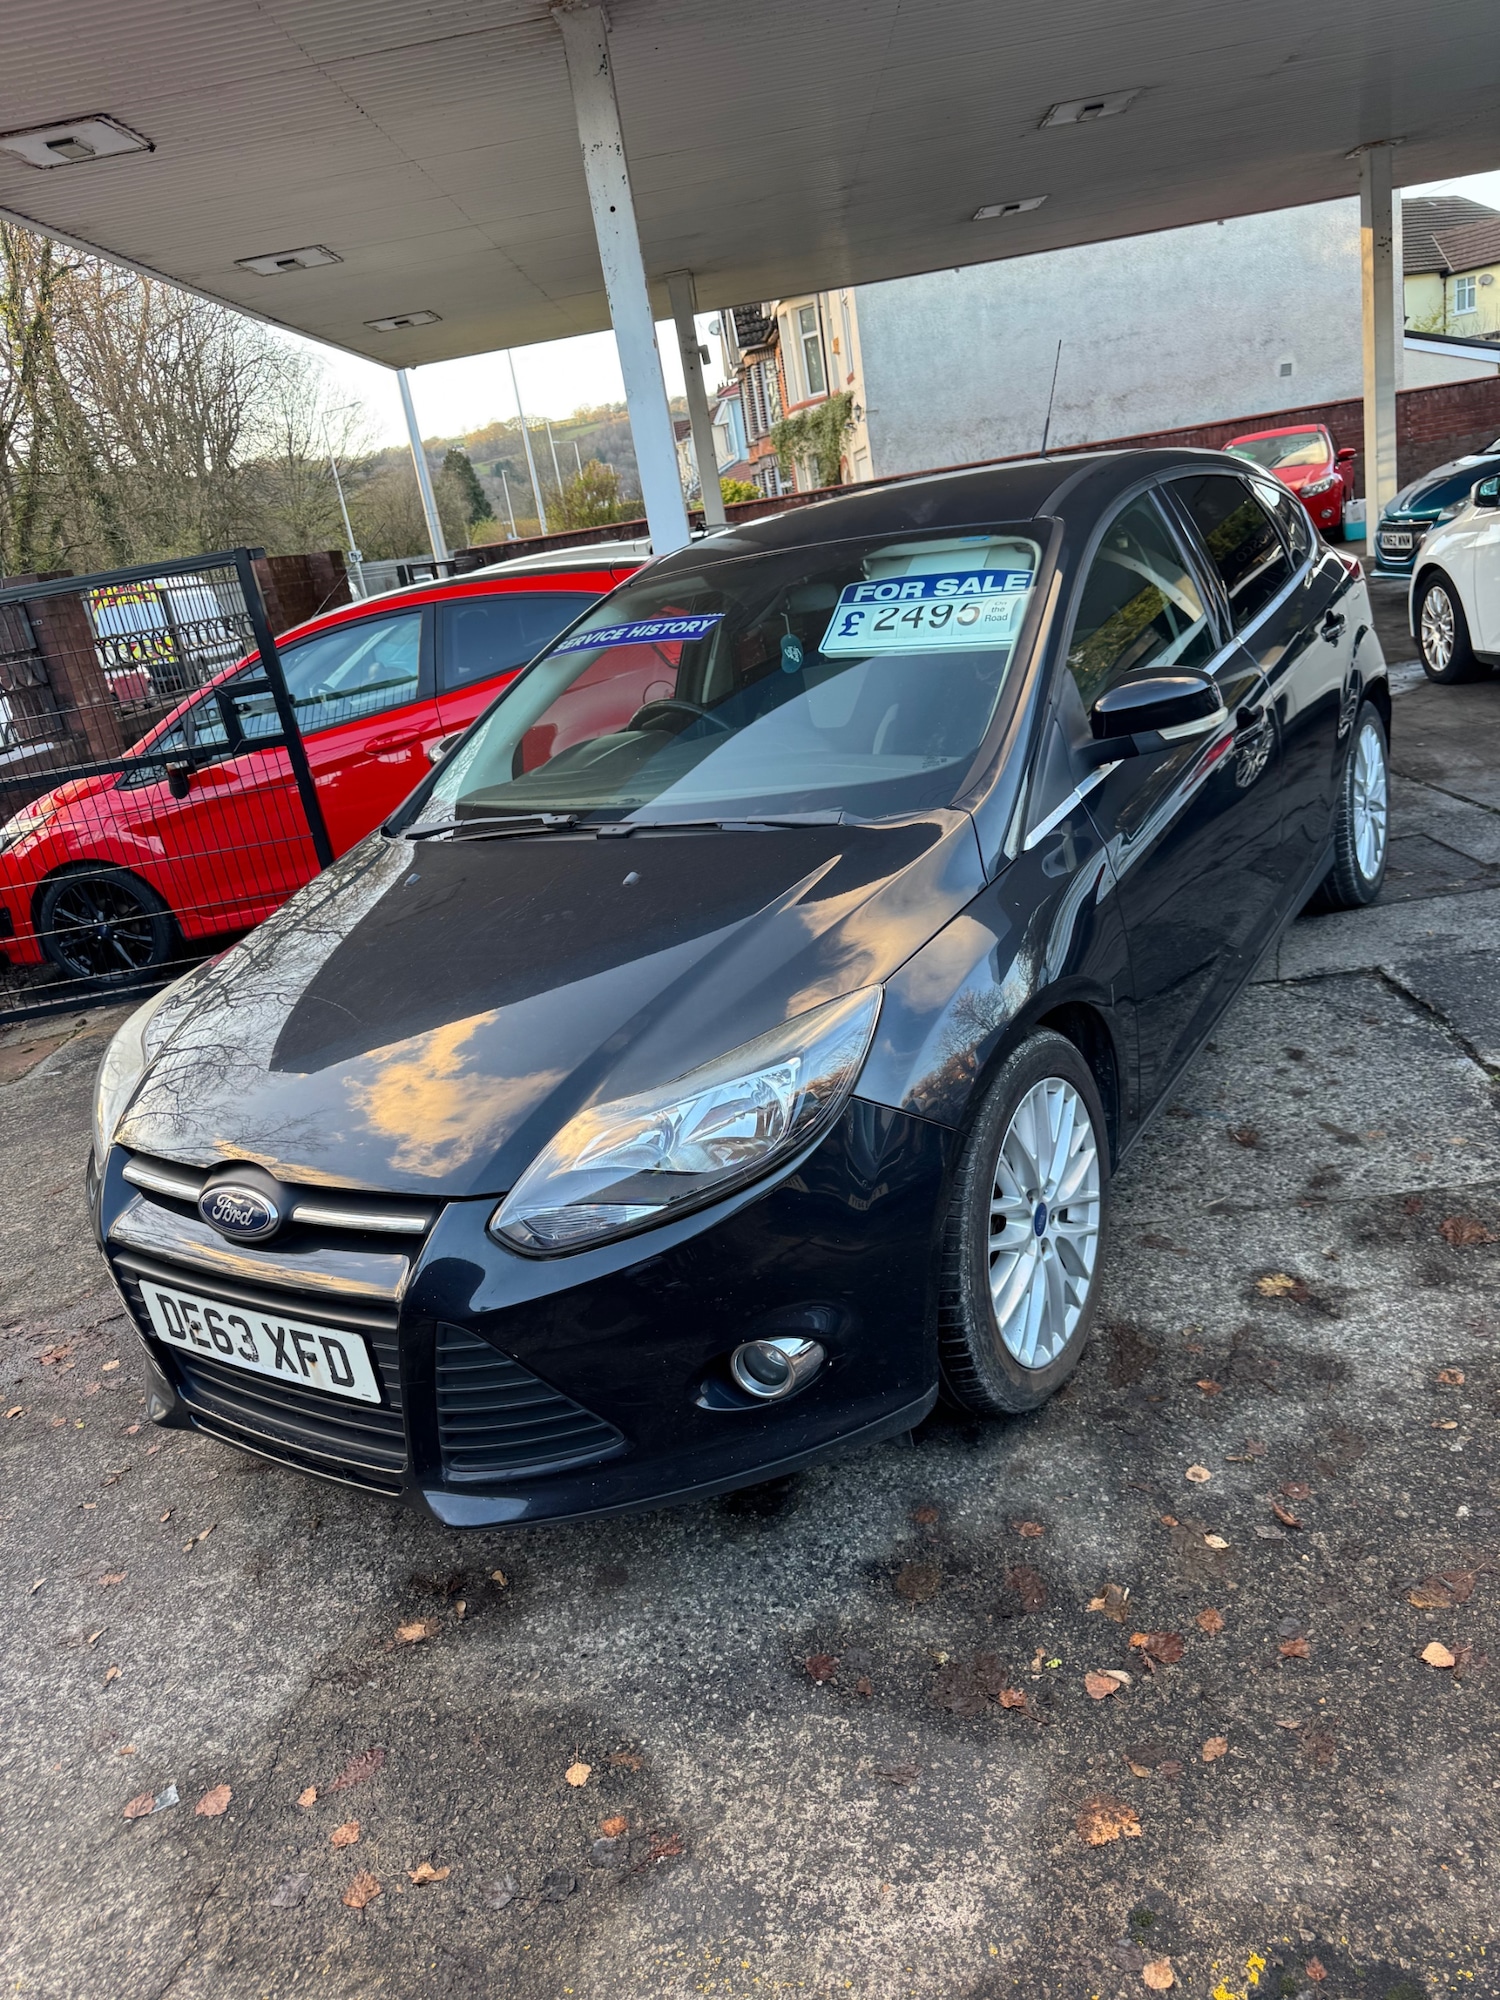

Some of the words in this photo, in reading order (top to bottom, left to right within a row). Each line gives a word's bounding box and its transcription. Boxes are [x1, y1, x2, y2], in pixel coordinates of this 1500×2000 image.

[853, 581, 925, 602] FOR
[933, 574, 1030, 597] SALE
[837, 611, 865, 637] £
[873, 601, 984, 631] 2495
[984, 613, 1008, 622] Road
[553, 627, 628, 653] SERVICE
[626, 619, 718, 639] HISTORY
[212, 1194, 254, 1226] Ford
[155, 1292, 260, 1364] DE63
[261, 1322, 355, 1388] XFD
